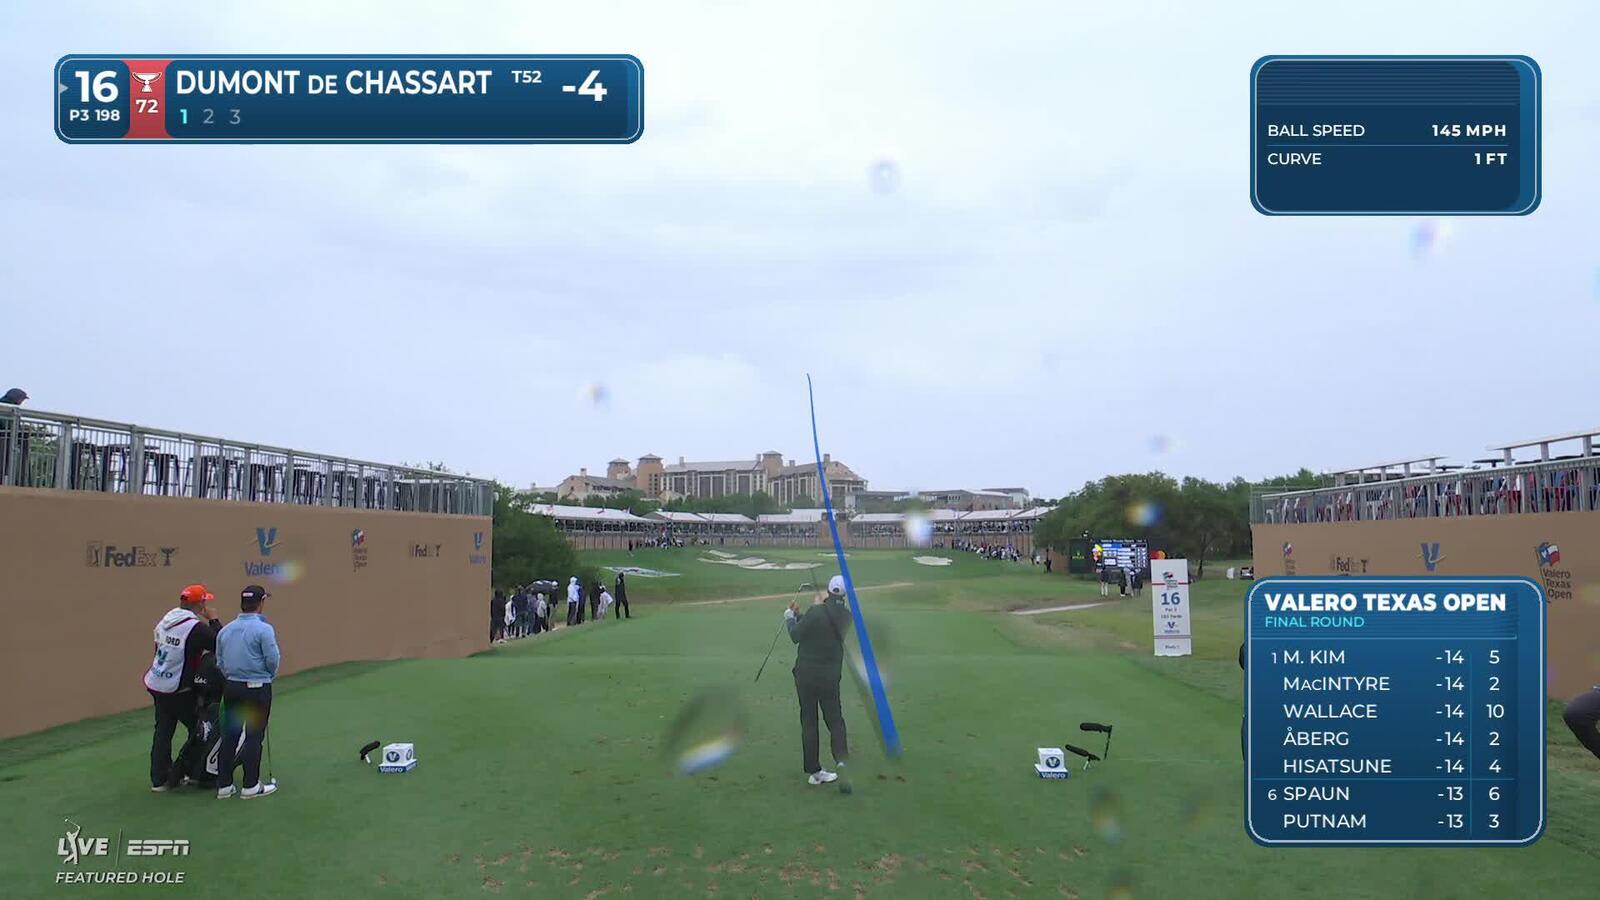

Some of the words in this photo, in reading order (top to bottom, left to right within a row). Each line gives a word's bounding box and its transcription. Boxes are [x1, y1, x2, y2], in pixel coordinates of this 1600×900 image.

[104, 546, 158, 568] FedEx
[245, 561, 290, 577] Valer
[1542, 568, 1571, 579] Valero
[1545, 579, 1571, 588] Texas
[1161, 592, 1181, 606] 16
[1547, 588, 1572, 600] Open
